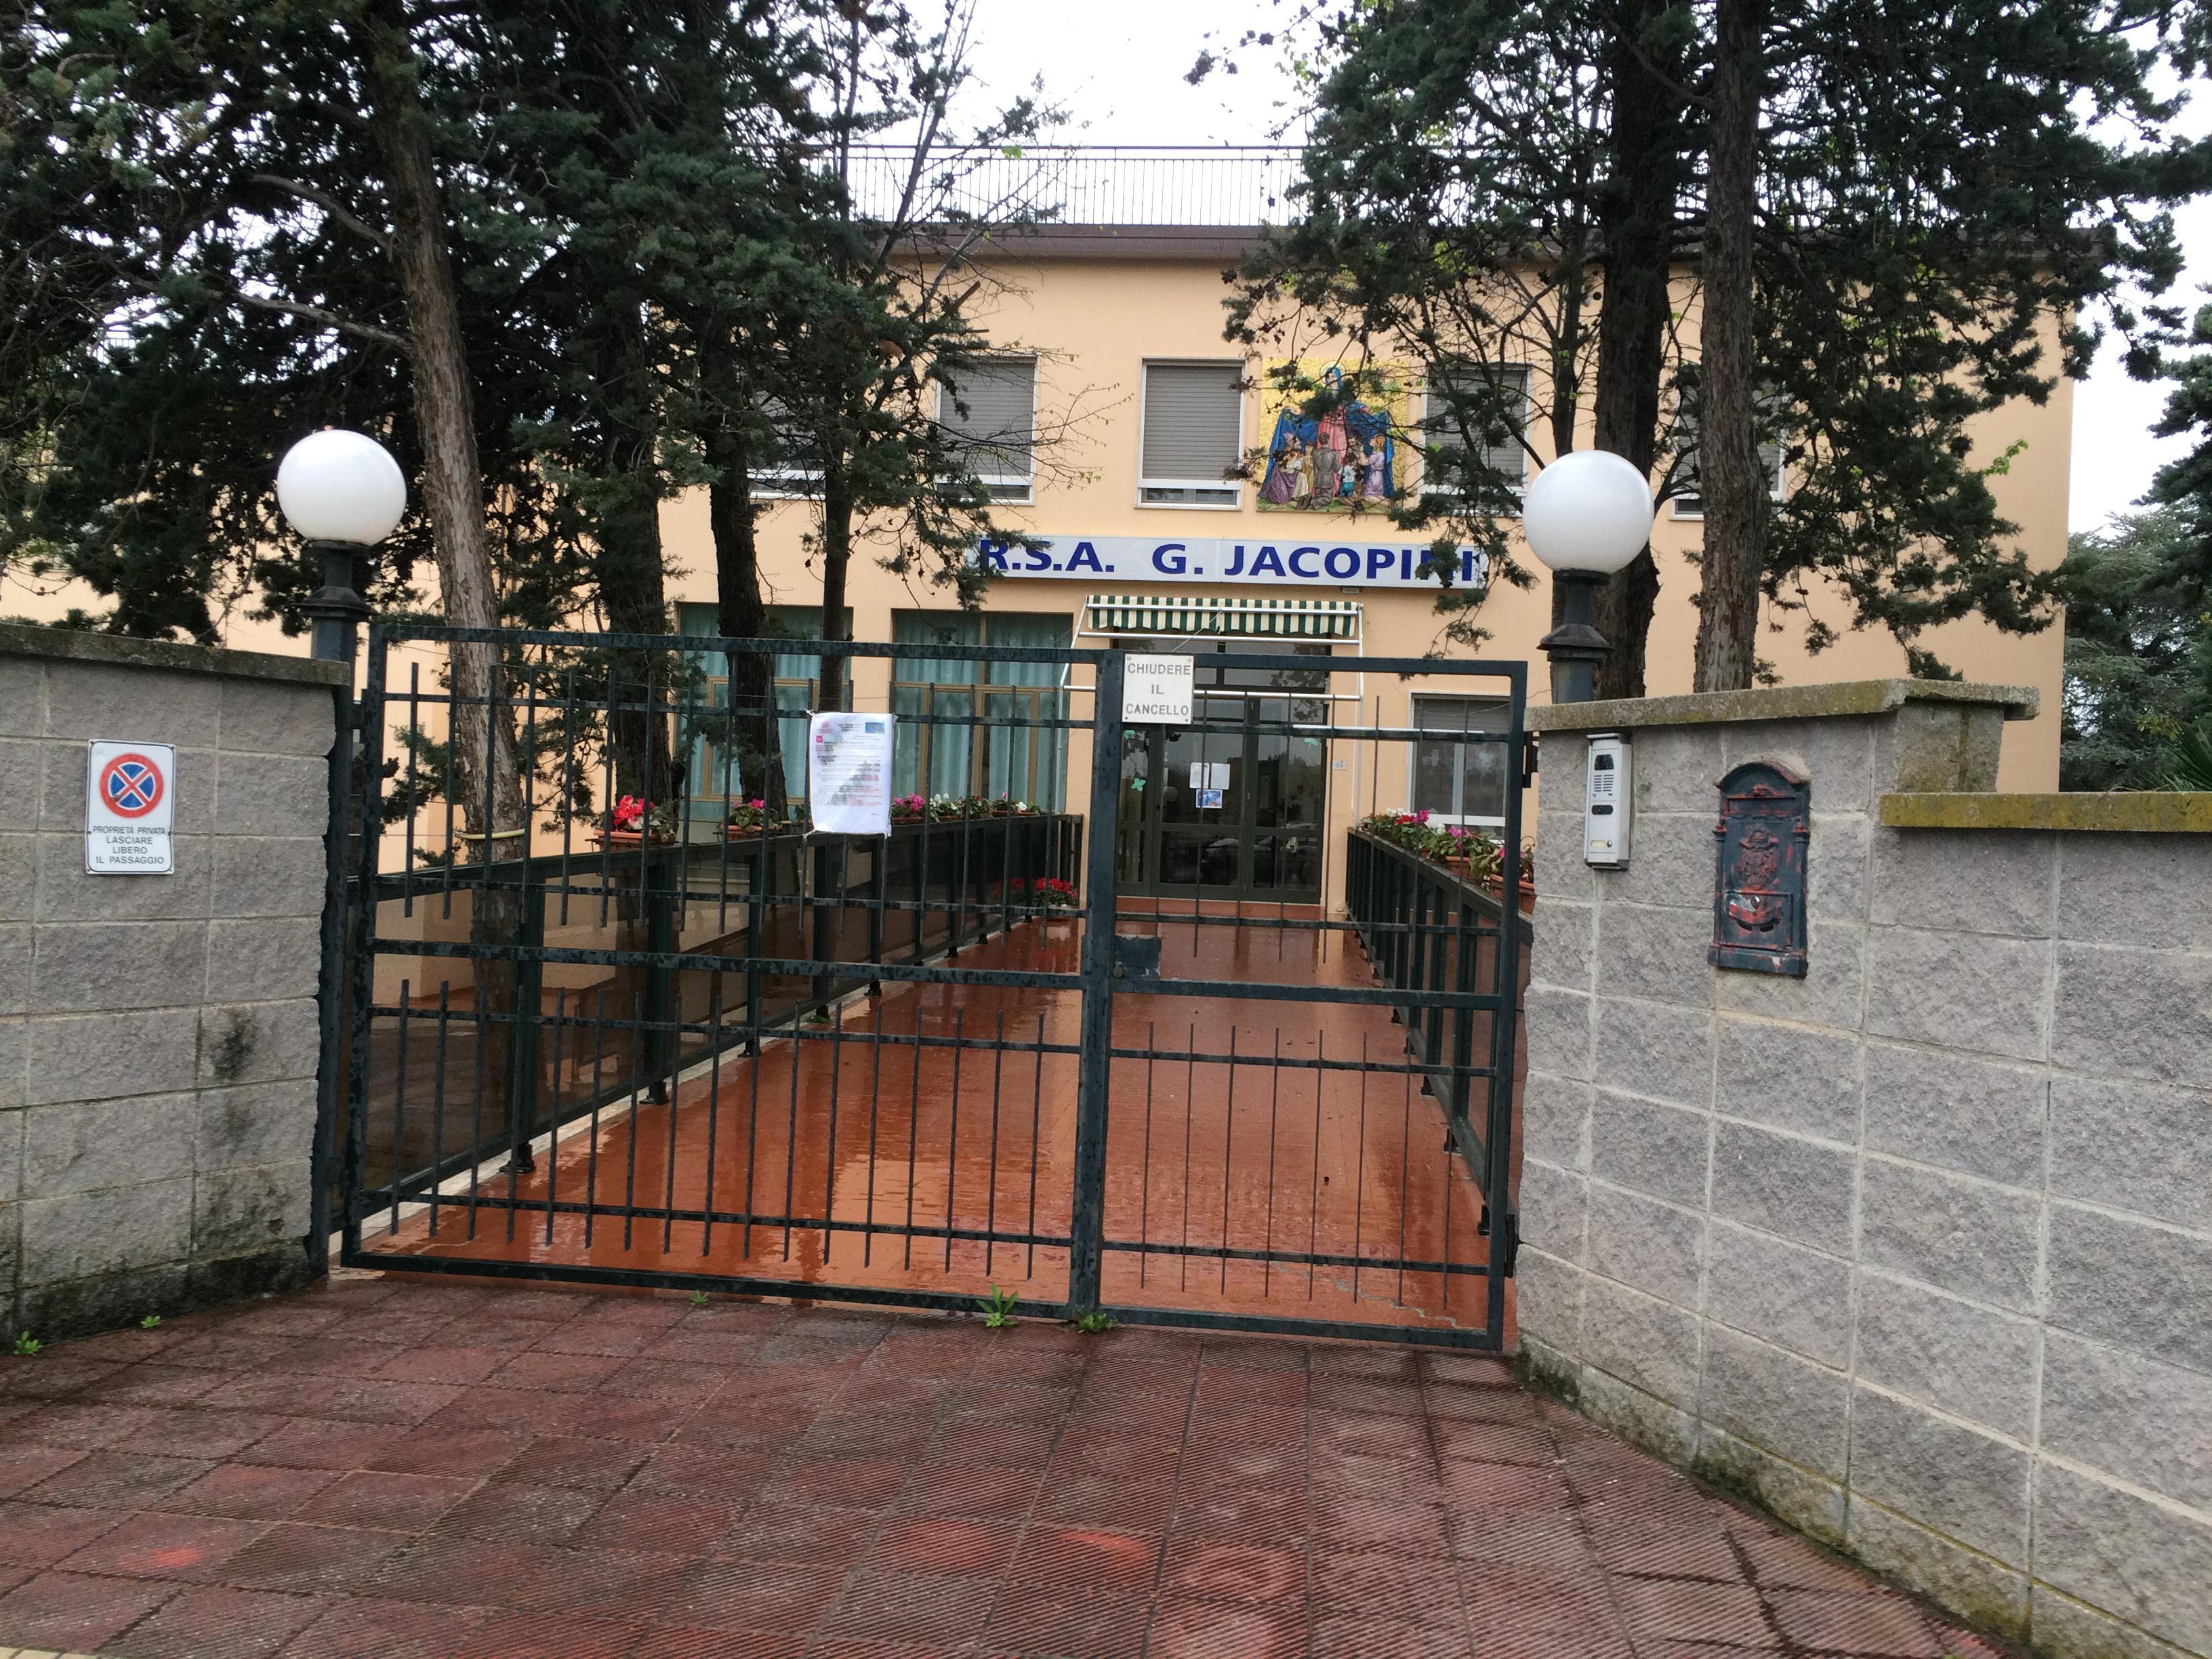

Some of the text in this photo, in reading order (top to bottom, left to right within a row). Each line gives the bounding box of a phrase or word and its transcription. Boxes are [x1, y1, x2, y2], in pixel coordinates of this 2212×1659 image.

[981, 540, 1115, 572] R.S.A.
[1152, 544, 1203, 575] G.
[1128, 663, 1191, 675] CHIUDERE
[1151, 684, 1165, 694] IL
[1126, 703, 1189, 715] CANCELLO
[106, 836, 152, 844] LASCIARE
[109, 856, 164, 864] PASSAGGIO
